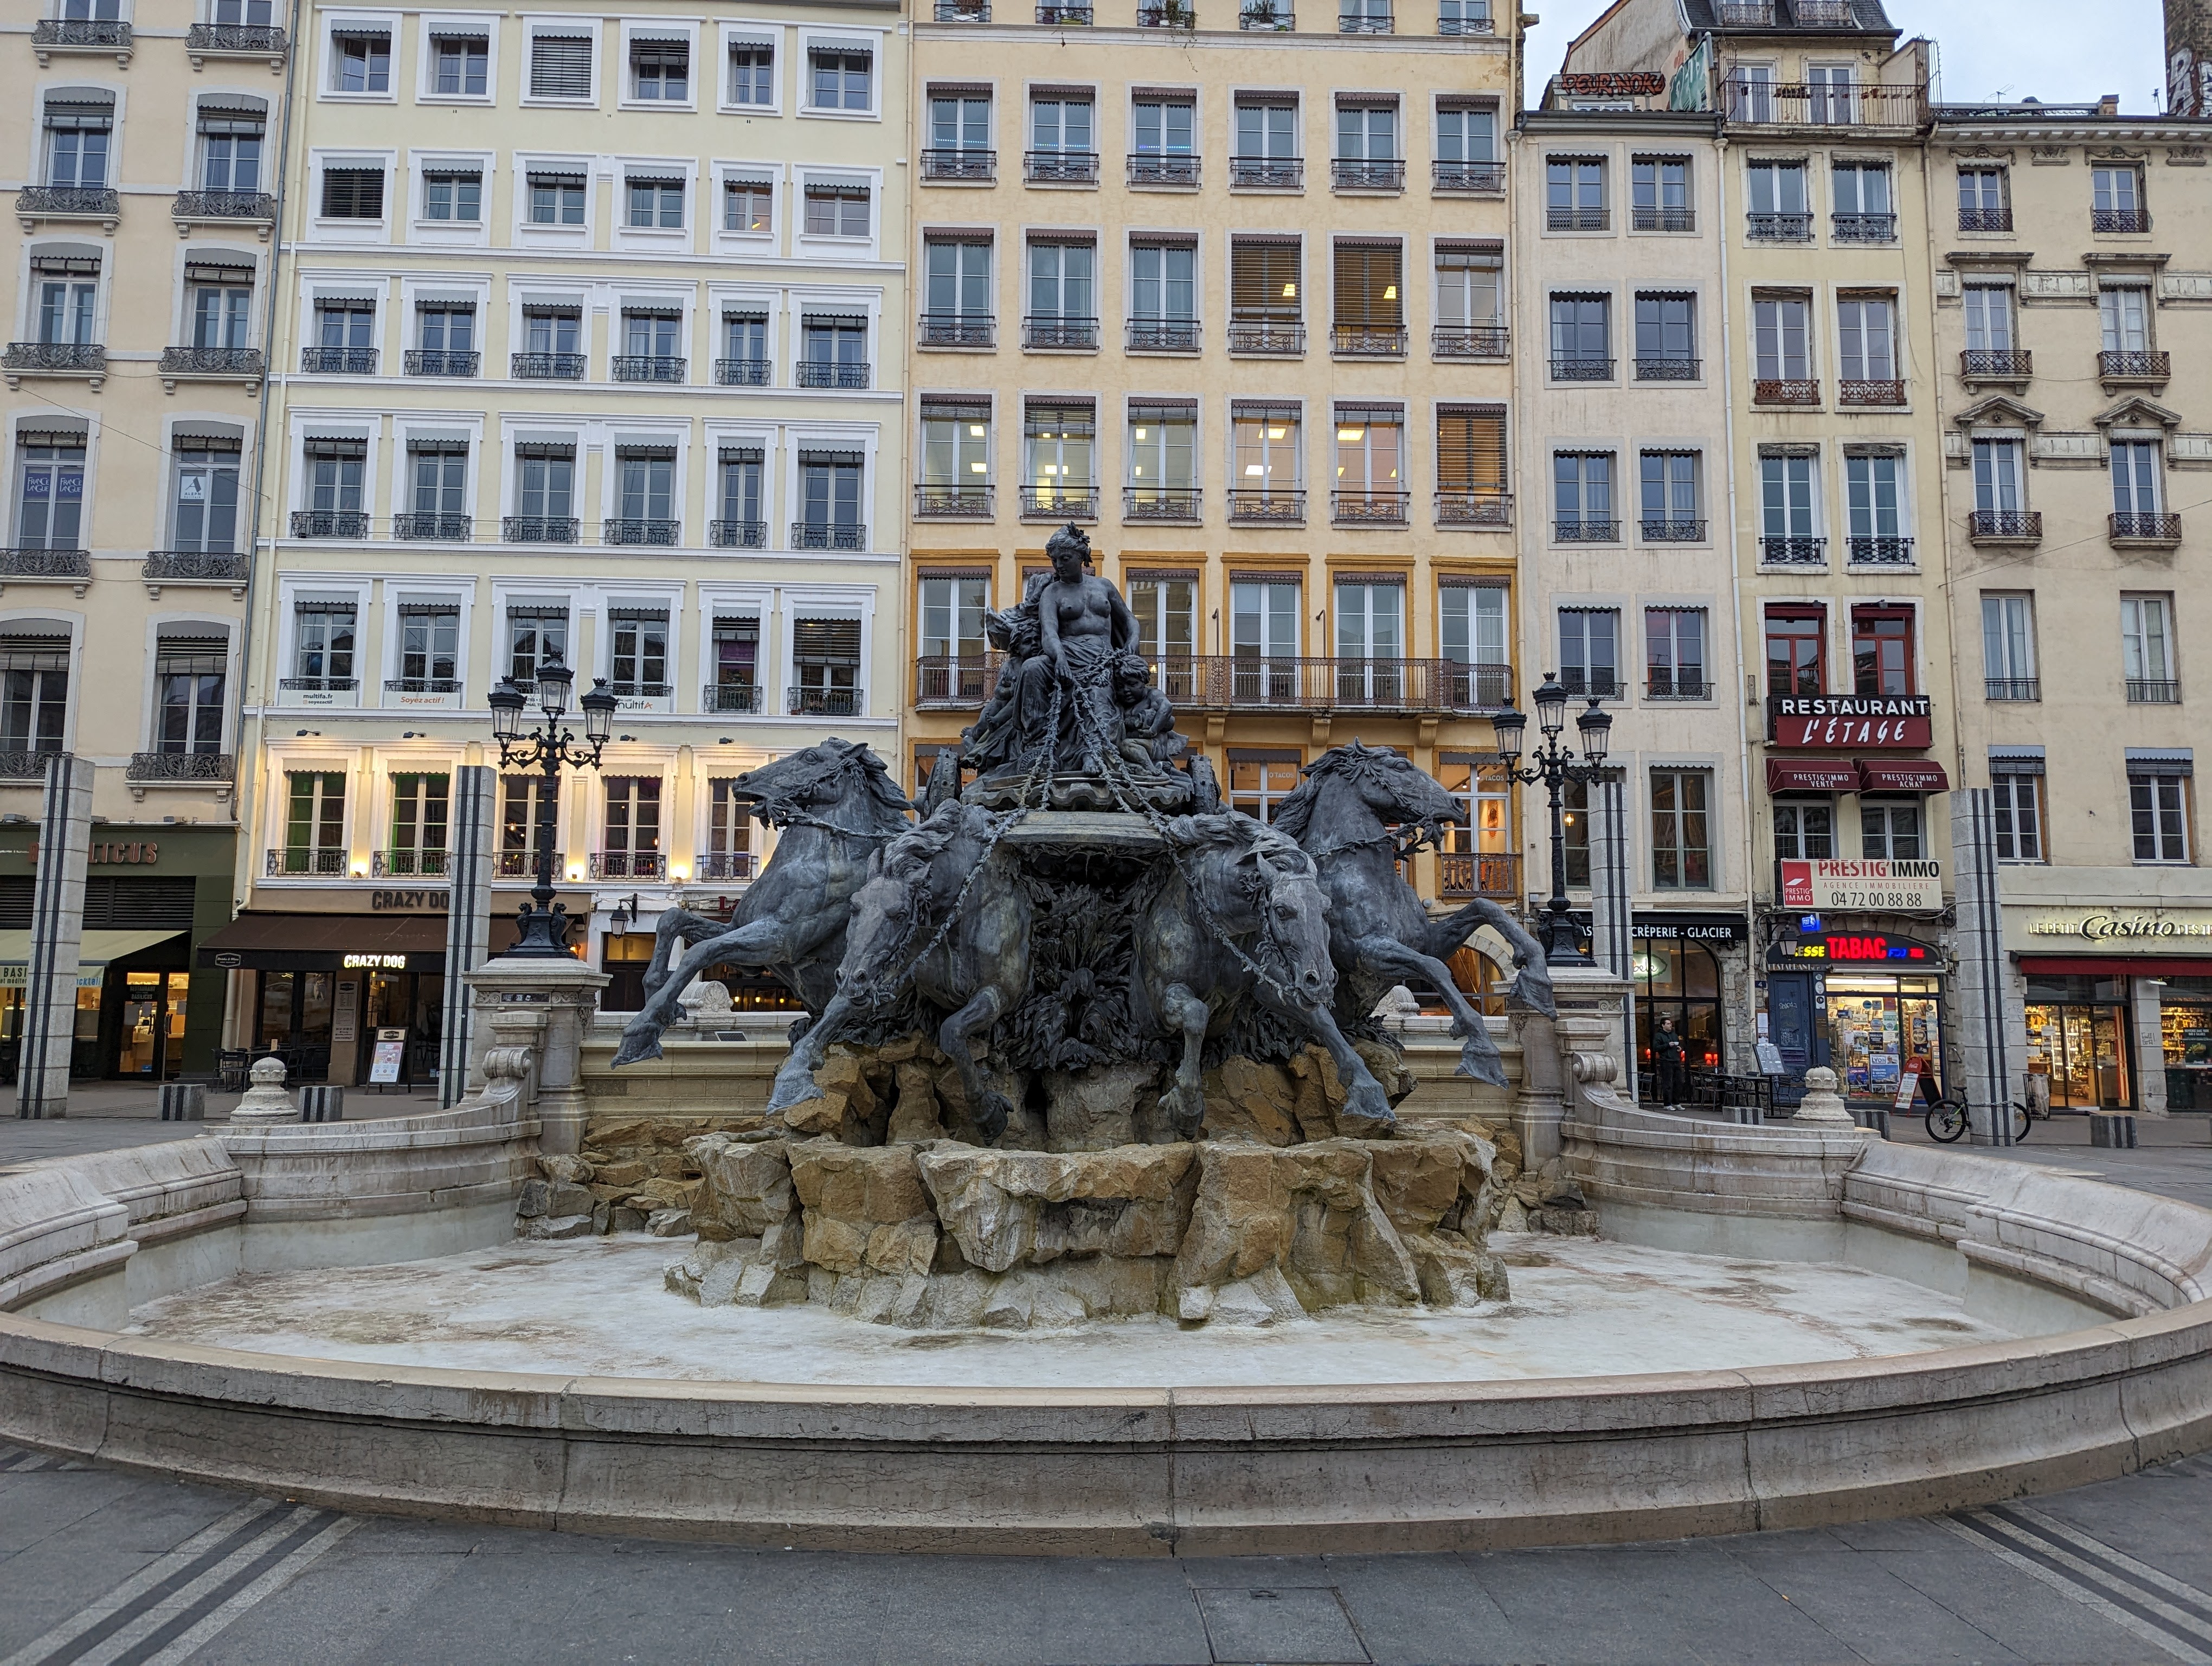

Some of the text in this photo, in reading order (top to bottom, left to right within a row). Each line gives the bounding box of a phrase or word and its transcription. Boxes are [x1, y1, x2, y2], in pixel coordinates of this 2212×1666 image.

[27, 484, 49, 492] LANGUE
[28, 477, 50, 485] FRANCE
[60, 477, 82, 486] FRANCE
[60, 485, 82, 493] LANGUE
[400, 696, 423, 704] Soyez
[1782, 699, 1928, 715] RESTAURANT
[1802, 716, 1906, 745] L'ÉTAGE
[1019, 751, 1041, 771] BARTH
[1793, 773, 1849, 782] PRESTIG'IMMO
[1881, 773, 1938, 782] PRESTIG'IMMO
[29, 841, 158, 863] BLICUS
[1817, 859, 1940, 878] PRESTIG'IMMO
[1823, 881, 1930, 890] AGENCE IMMOBILIERE
[371, 891, 450, 909] CRAZY DO
[1831, 891, 1922, 907] 04 72 00 88 88
[1631, 924, 1678, 938] CRÊPERIE
[1687, 927, 1732, 938] GLACIER
[2029, 922, 2043, 934] LE
[2045, 922, 2078, 934] PETIT
[2079, 915, 2175, 940] Casino
[2177, 924, 2200, 935] DES
[1826, 937, 1886, 959] TABAC
[343, 954, 406, 969] CRAZY DOG
[3, 967, 27, 978] BASI
[76, 977, 101, 986] cktail
